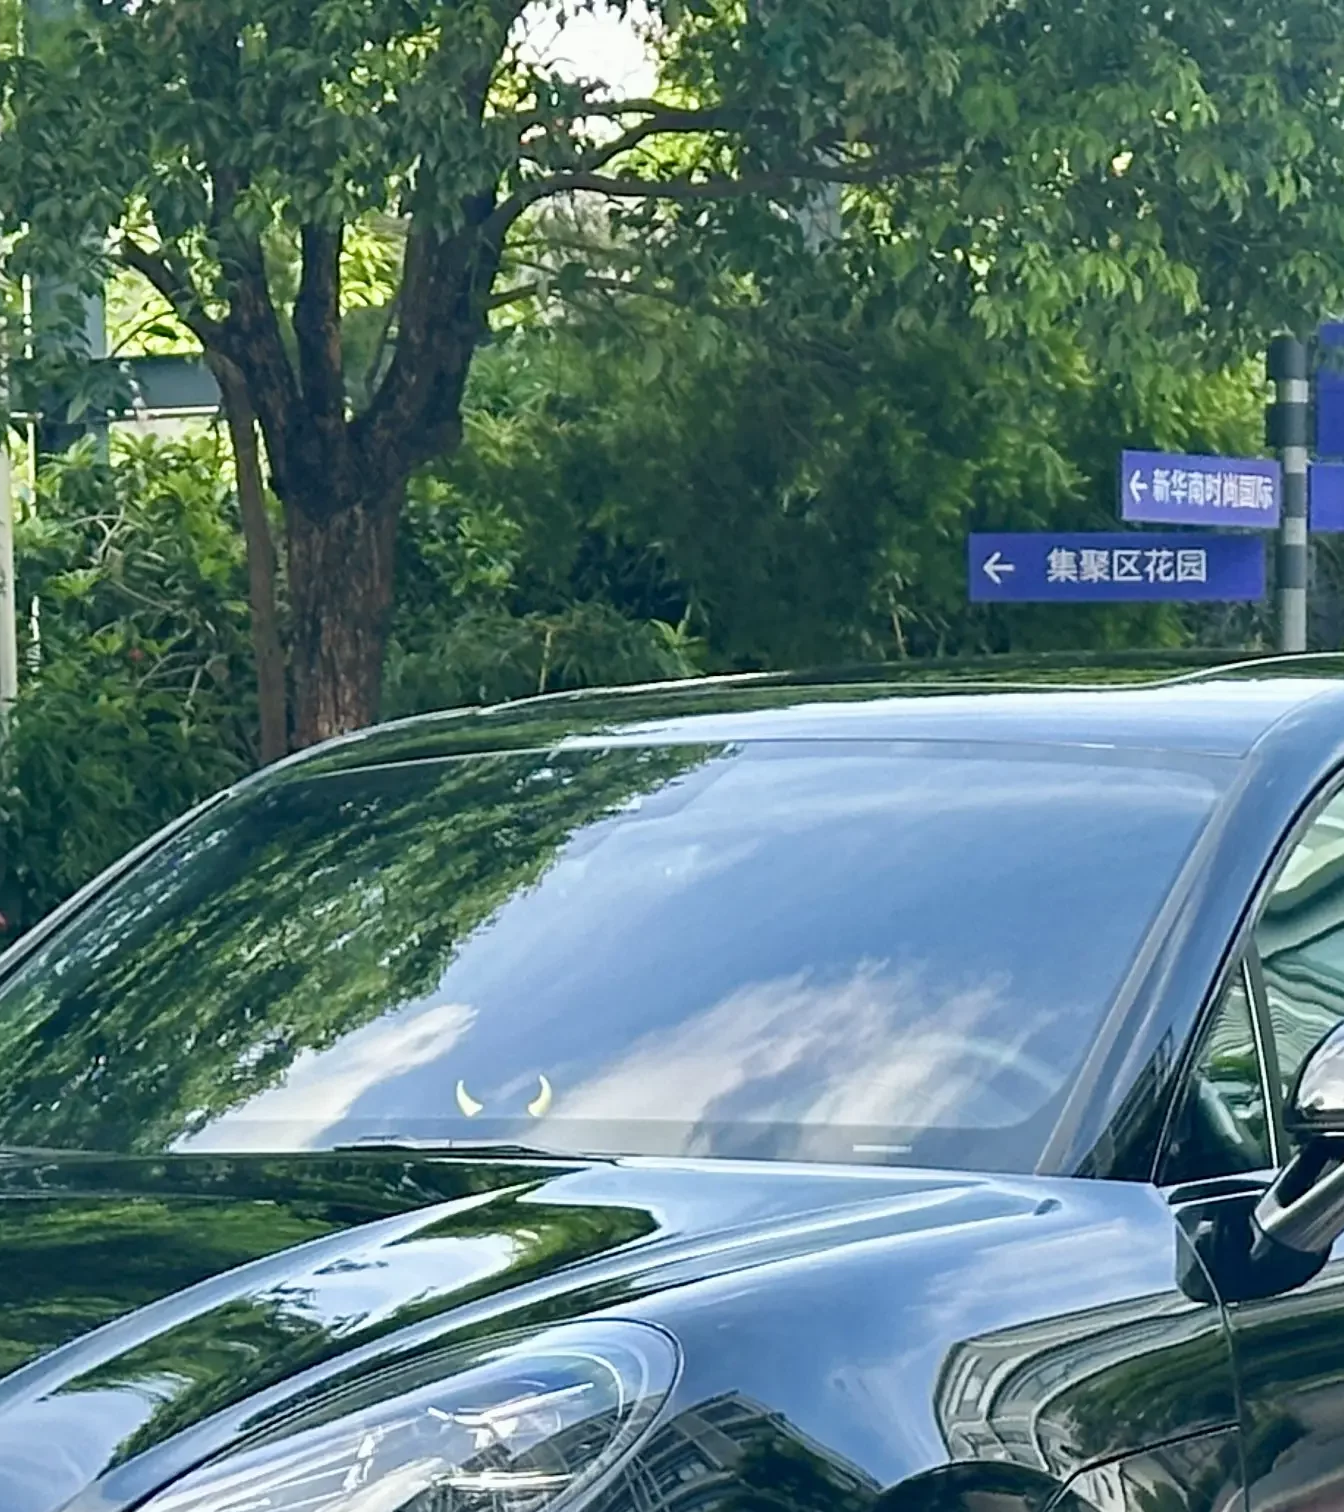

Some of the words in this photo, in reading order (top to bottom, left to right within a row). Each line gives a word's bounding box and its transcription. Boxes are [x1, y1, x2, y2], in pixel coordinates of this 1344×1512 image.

[1153, 468, 1274, 510] 新华南时尚国际
[1047, 548, 1207, 583] 集聚区花园
